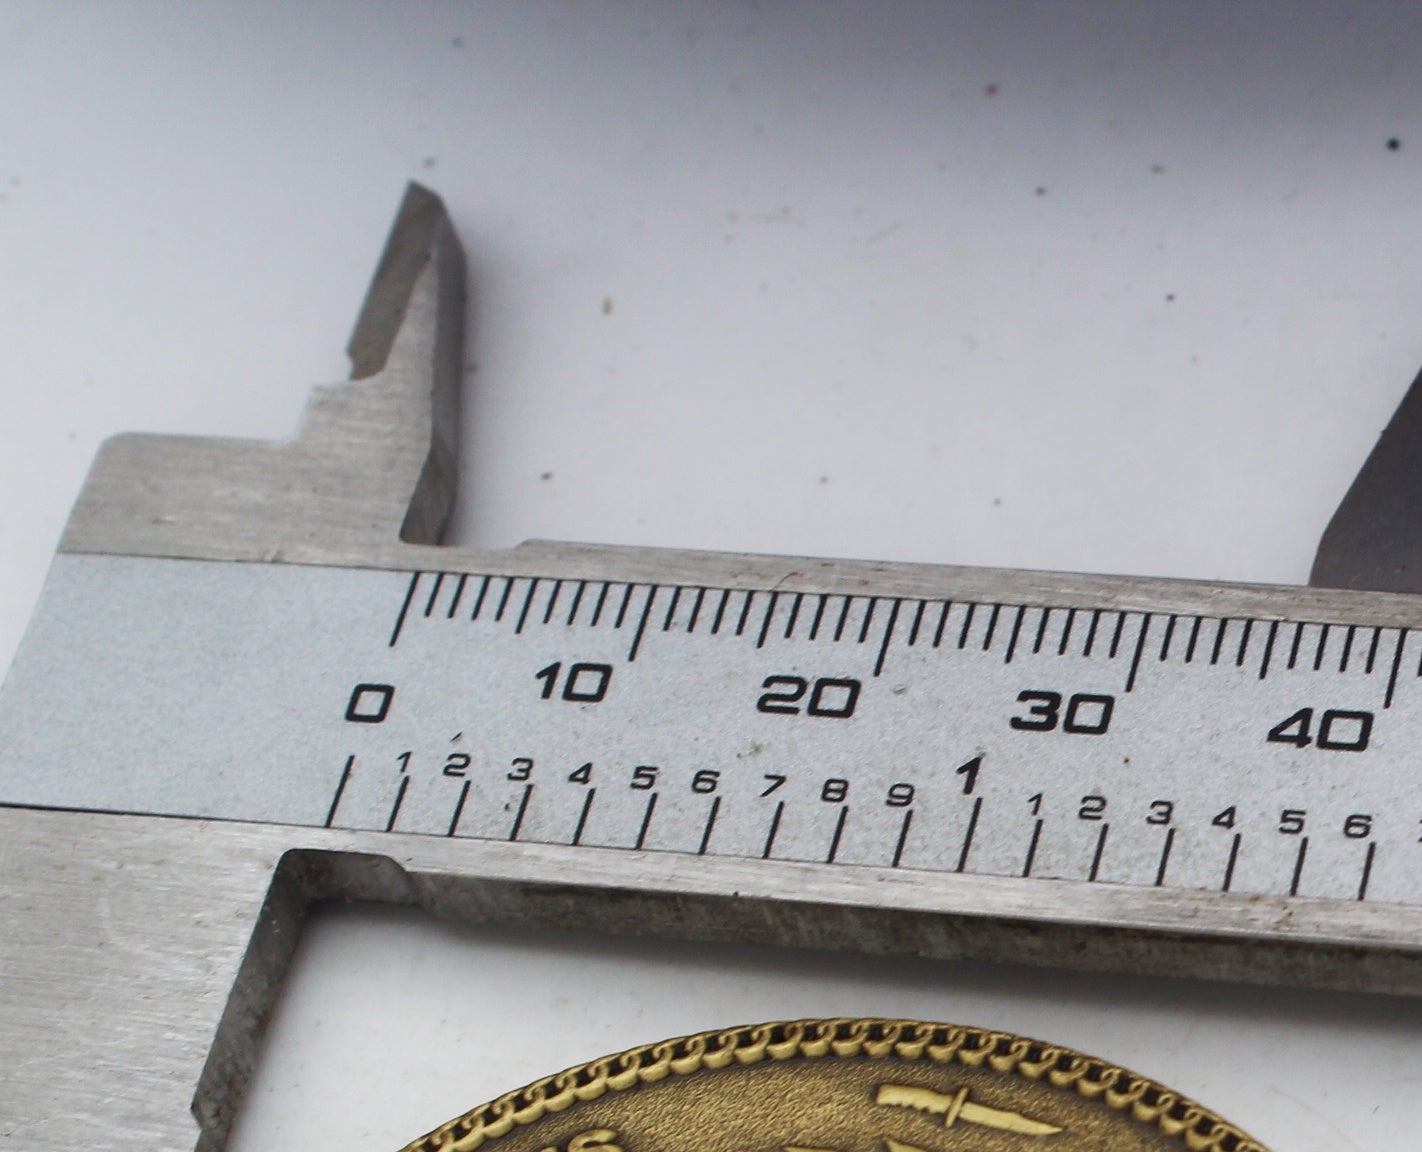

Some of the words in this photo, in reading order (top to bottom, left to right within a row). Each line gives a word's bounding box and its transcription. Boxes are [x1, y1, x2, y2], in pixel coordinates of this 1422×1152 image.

[343, 682, 397, 724] 0
[534, 660, 614, 703] 10
[756, 673, 862, 719] 20
[1008, 688, 1116, 736] 30
[1266, 706, 1376, 753] 40
[395, 750, 412, 774] 1
[442, 752, 473, 778] 2
[505, 757, 535, 782] 3
[567, 762, 594, 786] 4
[629, 765, 659, 791] 5
[690, 769, 721, 795] 6
[758, 773, 787, 798] 7
[819, 777, 851, 804] 8
[885, 782, 916, 808] 9
[955, 753, 986, 796] 1
[1026, 792, 1043, 816] 1
[1077, 795, 1107, 821] 2
[1145, 800, 1175, 826] 3
[1211, 805, 1238, 830] 4
[1278, 809, 1308, 835] 5
[1343, 814, 1373, 840] 6
